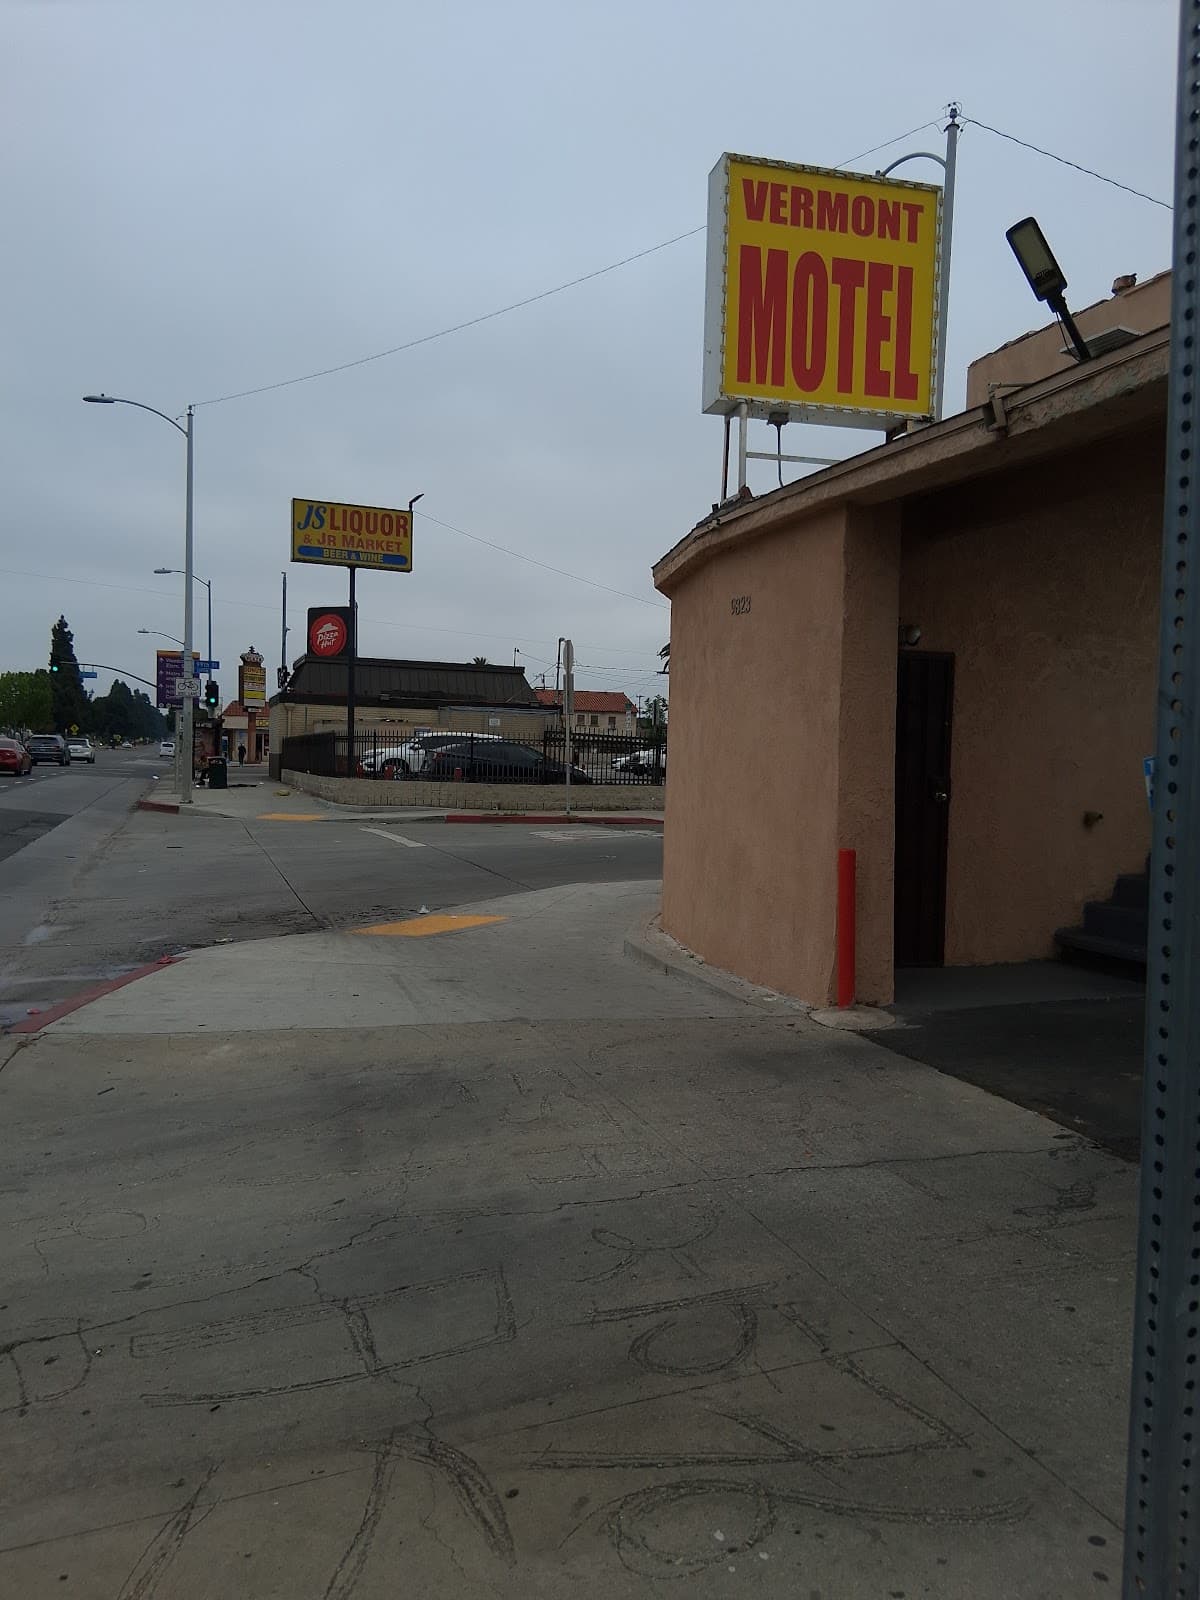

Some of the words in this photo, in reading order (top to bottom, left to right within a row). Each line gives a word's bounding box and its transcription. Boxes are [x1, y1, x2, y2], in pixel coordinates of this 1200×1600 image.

[742, 178, 924, 244] VERMONT
[737, 245, 919, 400] MOTEL
[297, 504, 327, 530] JS
[329, 507, 408, 538] LIQUOR
[303, 533, 313, 545] &
[317, 532, 336, 547] JR
[341, 535, 403, 553] MARKET
[323, 548, 349, 560] BEER
[359, 552, 384, 563] WINE
[317, 631, 339, 645] Pizza
[320, 639, 337, 649] Hut
